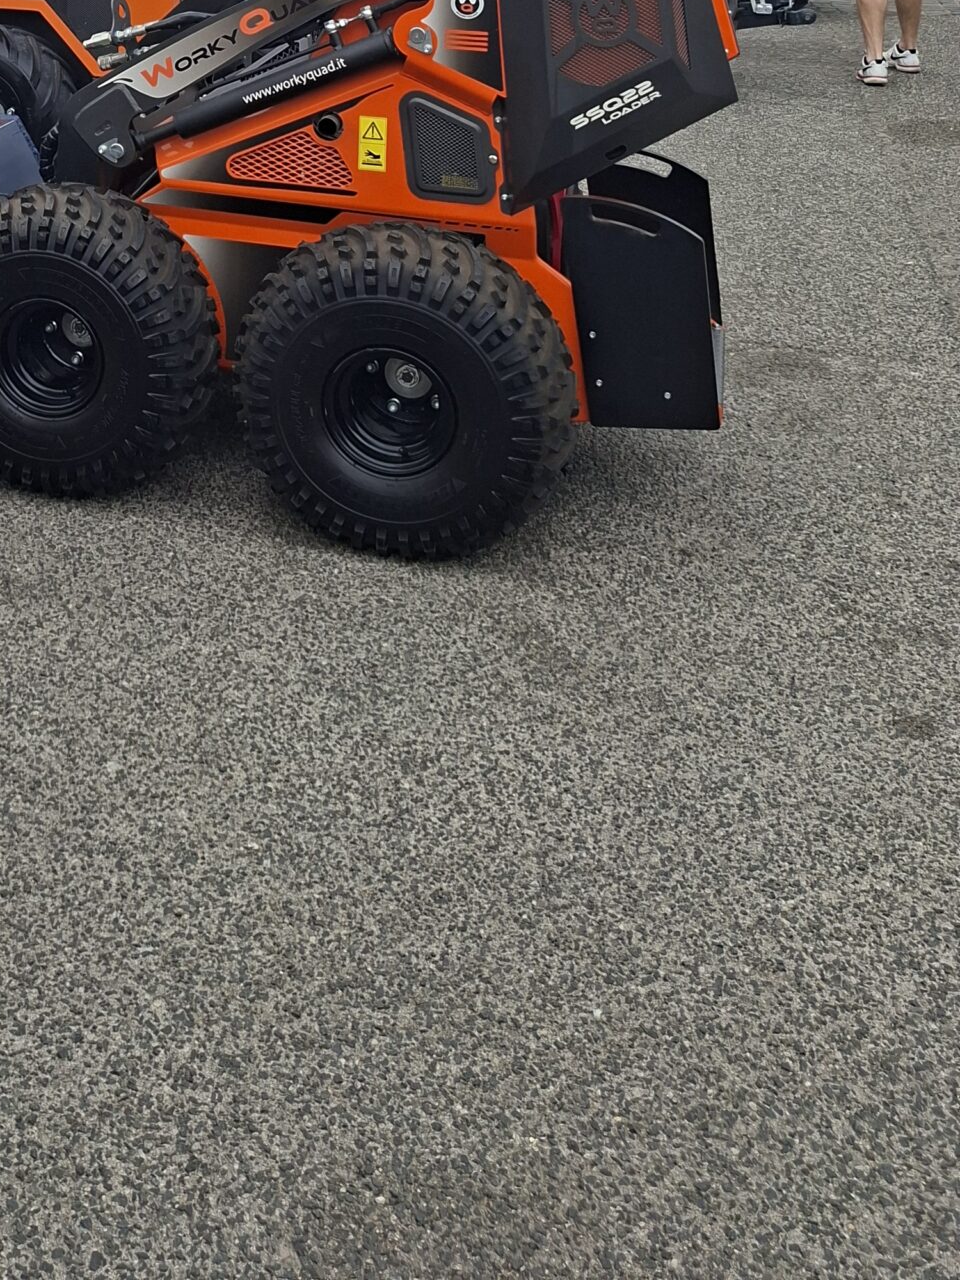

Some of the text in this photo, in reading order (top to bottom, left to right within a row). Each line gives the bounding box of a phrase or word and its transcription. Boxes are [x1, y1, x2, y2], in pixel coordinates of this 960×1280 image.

[242, 58, 347, 105] www.workyquad.it
[570, 80, 655, 131] SSQ22
[601, 90, 662, 125] LOADER
